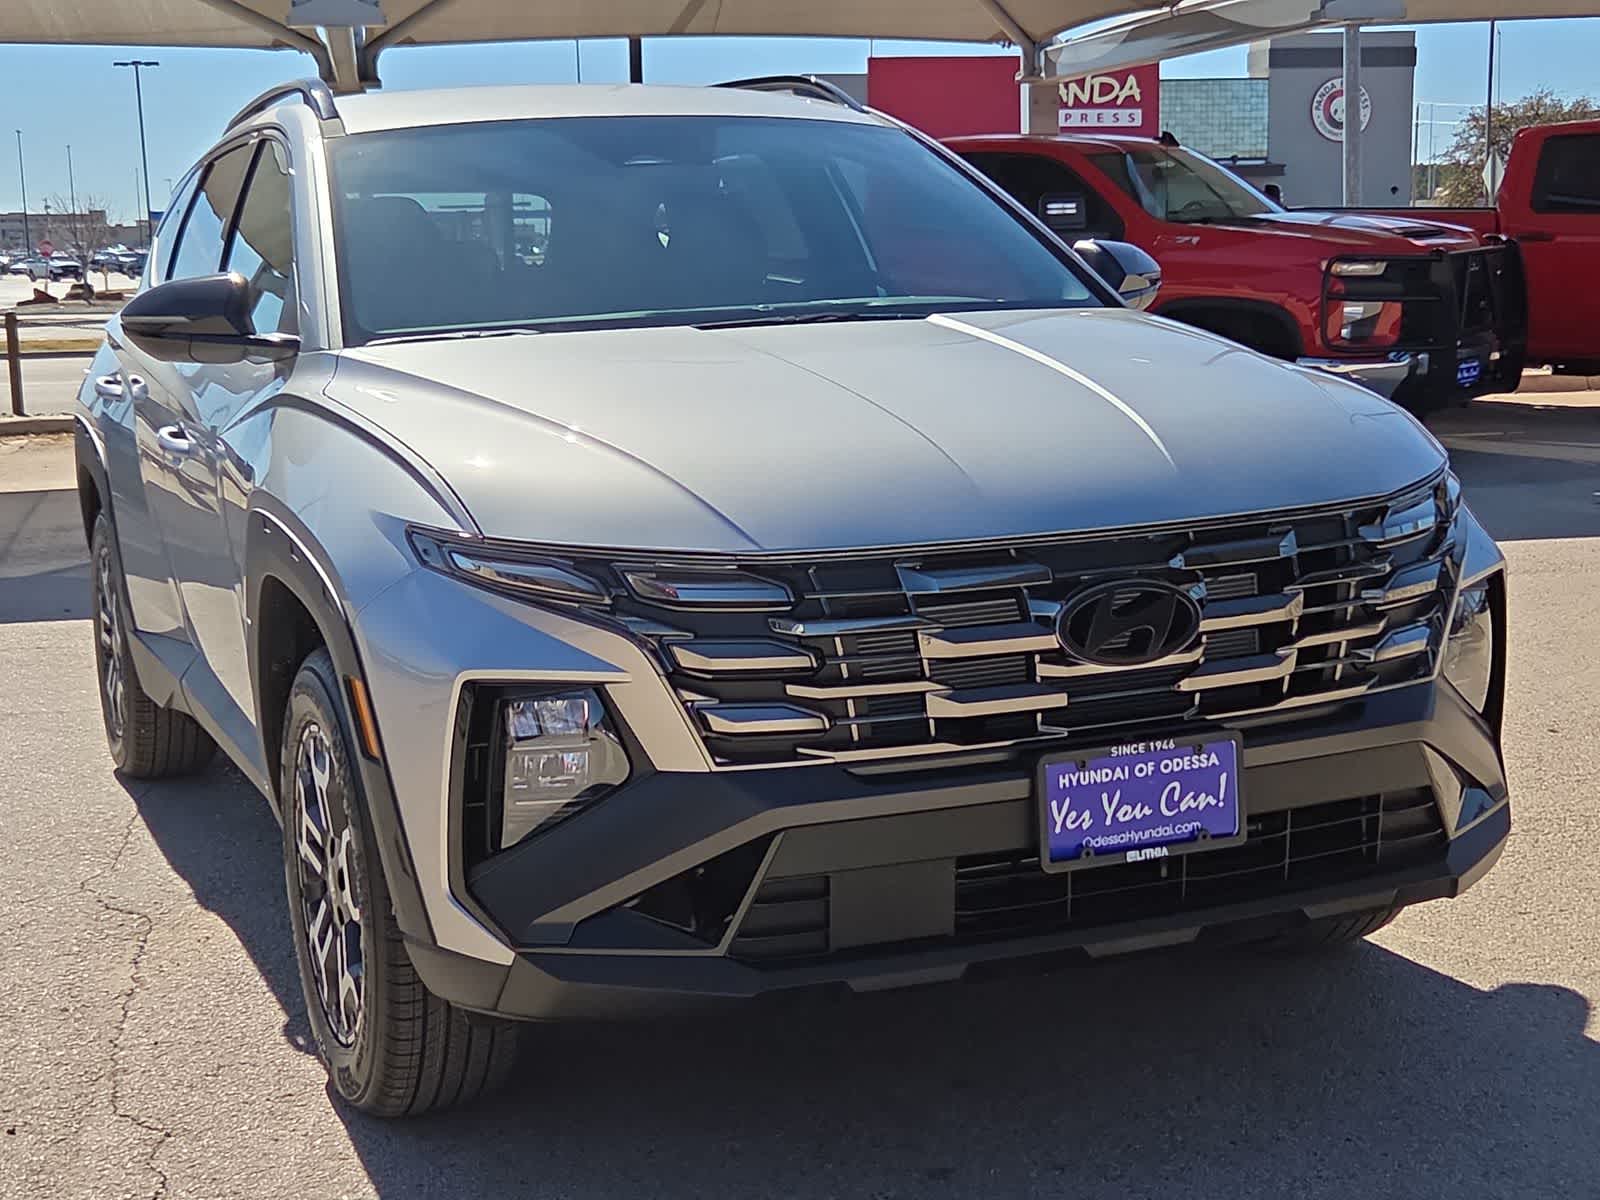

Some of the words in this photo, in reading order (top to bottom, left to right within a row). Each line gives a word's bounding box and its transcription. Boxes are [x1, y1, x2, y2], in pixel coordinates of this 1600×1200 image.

[1111, 743, 1145, 757] SINCE
[1149, 739, 1175, 752] 1946
[1059, 768, 1129, 789] HYUNDAI
[1134, 762, 1155, 778] OF
[1160, 752, 1219, 774] ODESSA
[1051, 797, 1093, 834] Yes
[1101, 789, 1152, 826] You
[1160, 772, 1227, 817] Can!
[1082, 821, 1201, 848] OdessaHyundai.com
